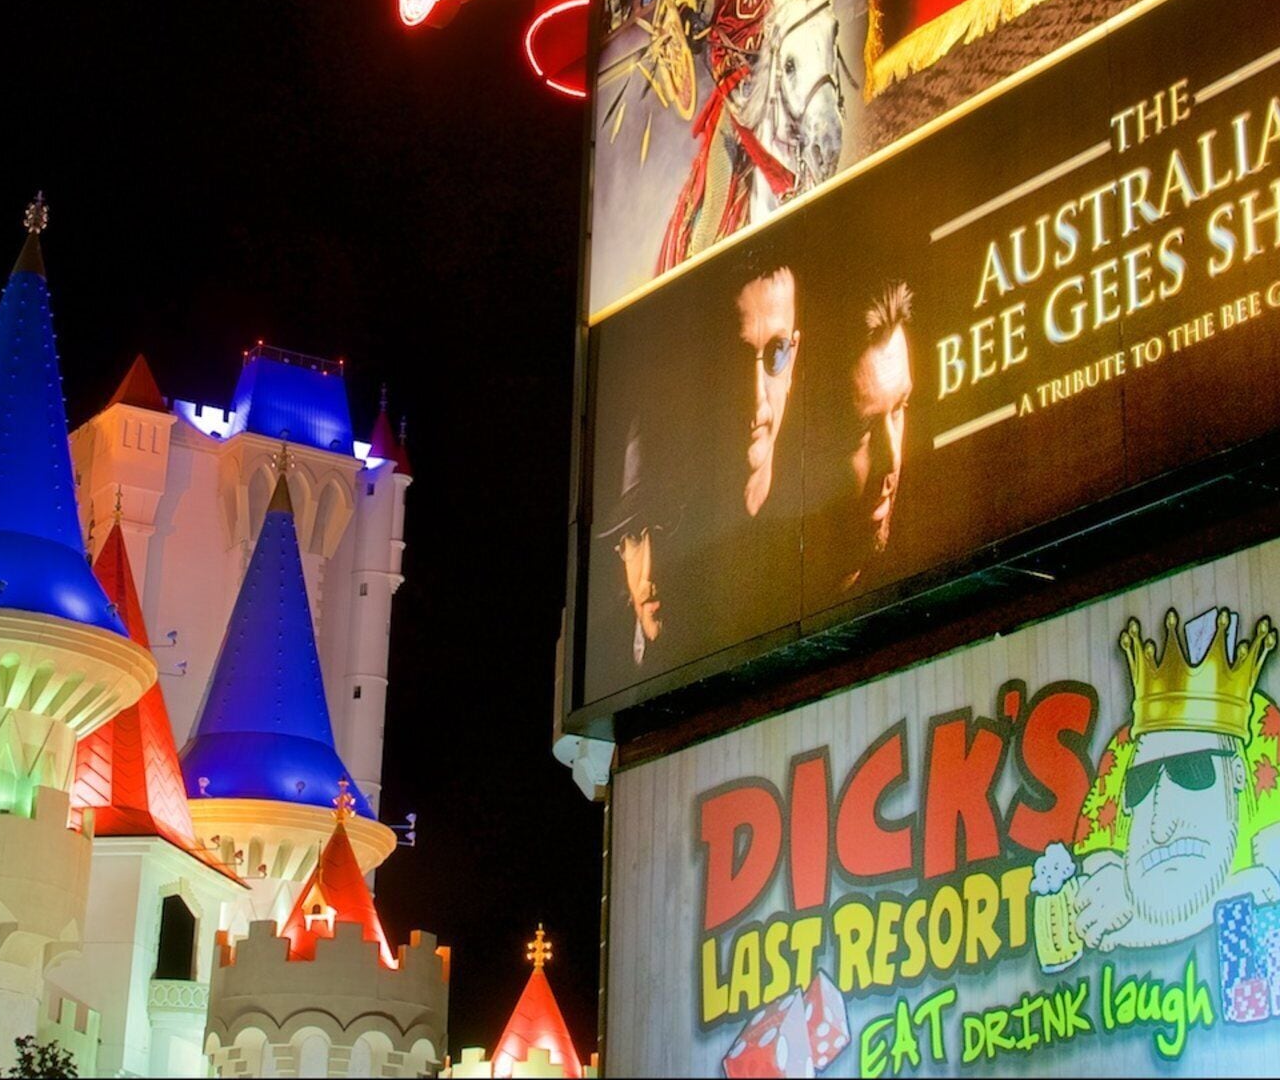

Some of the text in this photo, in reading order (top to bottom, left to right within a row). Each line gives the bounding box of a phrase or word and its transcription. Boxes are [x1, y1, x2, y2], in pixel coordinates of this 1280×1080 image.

[1110, 77, 1192, 153] THE
[936, 302, 1029, 401] BEE
[1043, 226, 1186, 345] GEES
[1018, 391, 1033, 417] A
[1037, 351, 1126, 409] TRIBUTE
[1130, 338, 1163, 366] TO
[1168, 307, 1215, 351] THE
[1220, 286, 1262, 331] BEE
[698, 685, 1096, 931] DICK'S
[702, 866, 1033, 1022] LAST RESORT
[860, 956, 1214, 1078] EAT DRINK laugh
